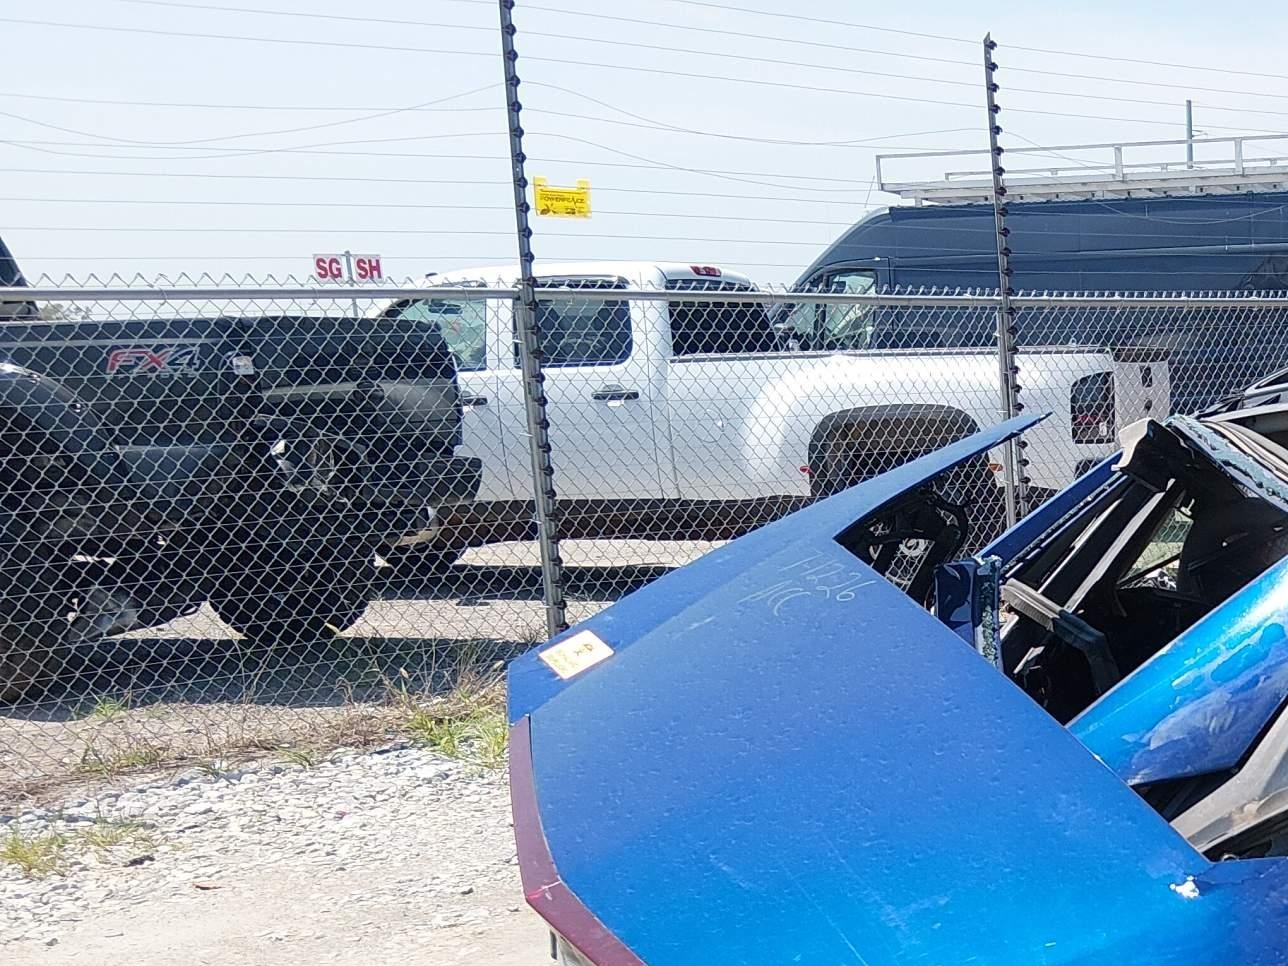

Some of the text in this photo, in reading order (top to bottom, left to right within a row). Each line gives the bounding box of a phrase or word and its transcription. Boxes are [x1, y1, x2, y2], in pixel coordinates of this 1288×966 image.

[316, 257, 382, 280] SG SH
[106, 347, 200, 374] FX4
